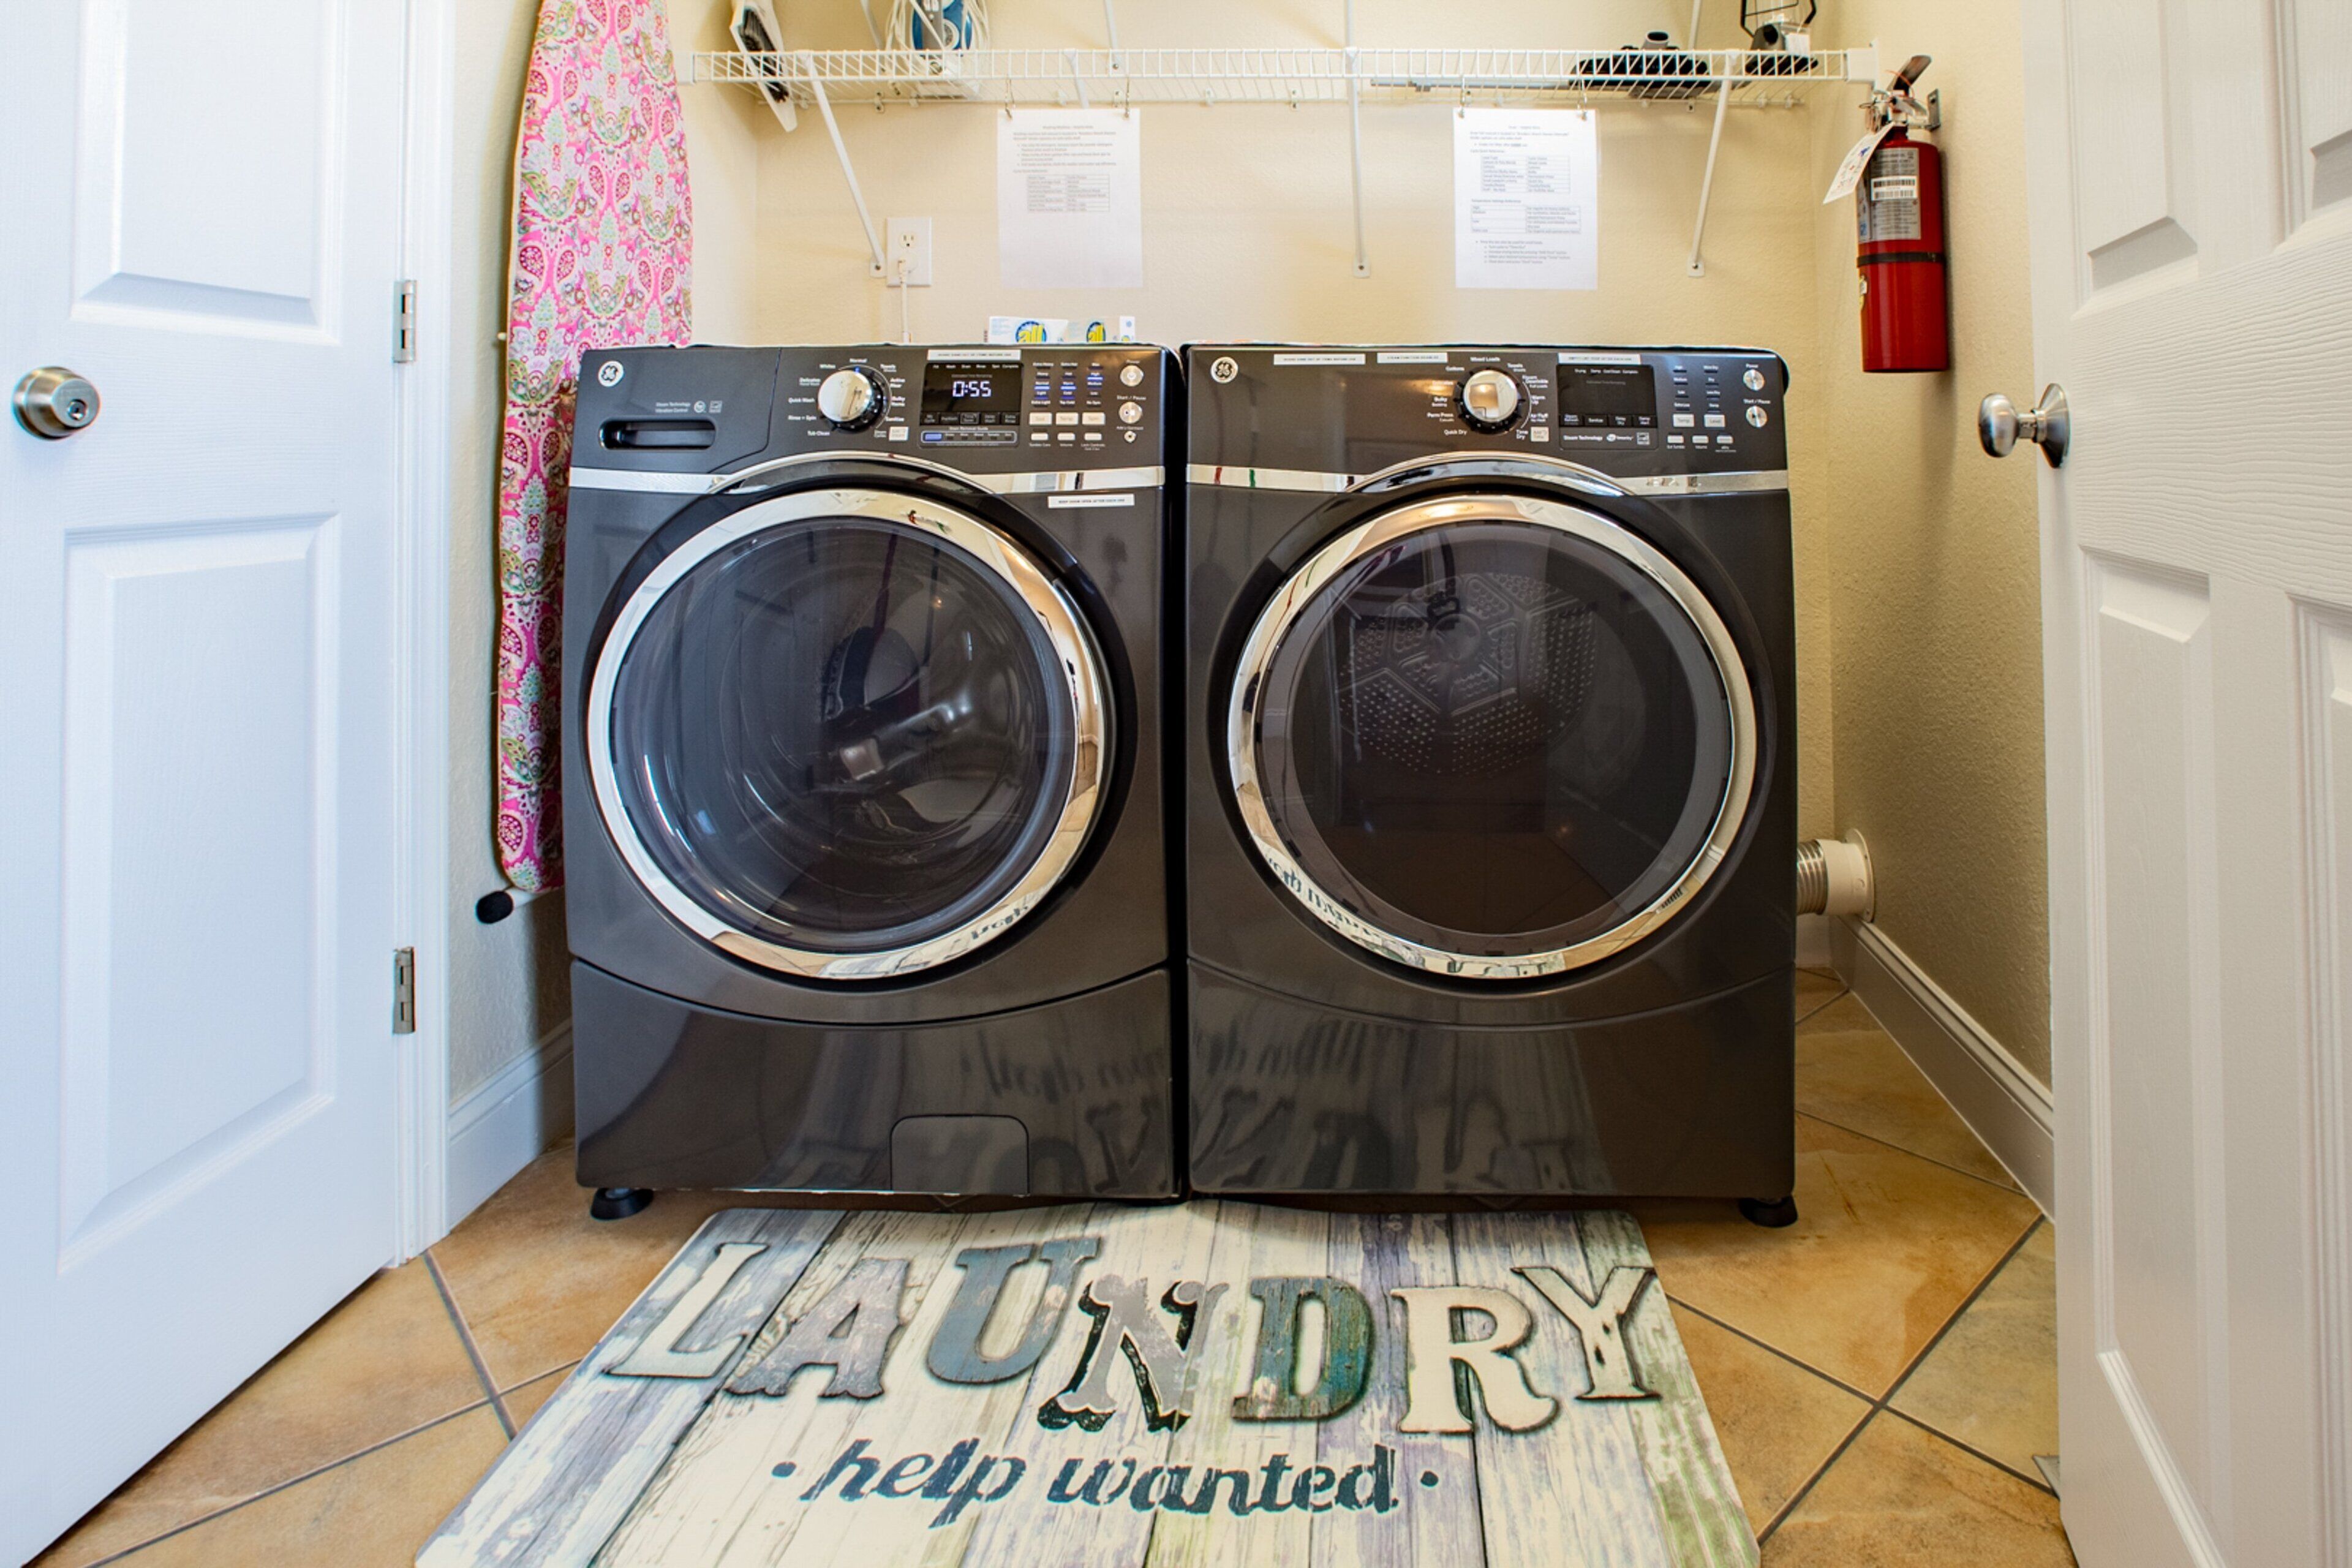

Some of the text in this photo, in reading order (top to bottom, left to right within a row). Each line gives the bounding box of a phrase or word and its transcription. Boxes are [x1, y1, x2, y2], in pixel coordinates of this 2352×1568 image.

[952, 380, 992, 397] 0:55
[600, 1236, 1664, 1436] LAUNDRY
[799, 1437, 1400, 1529] help wanted
